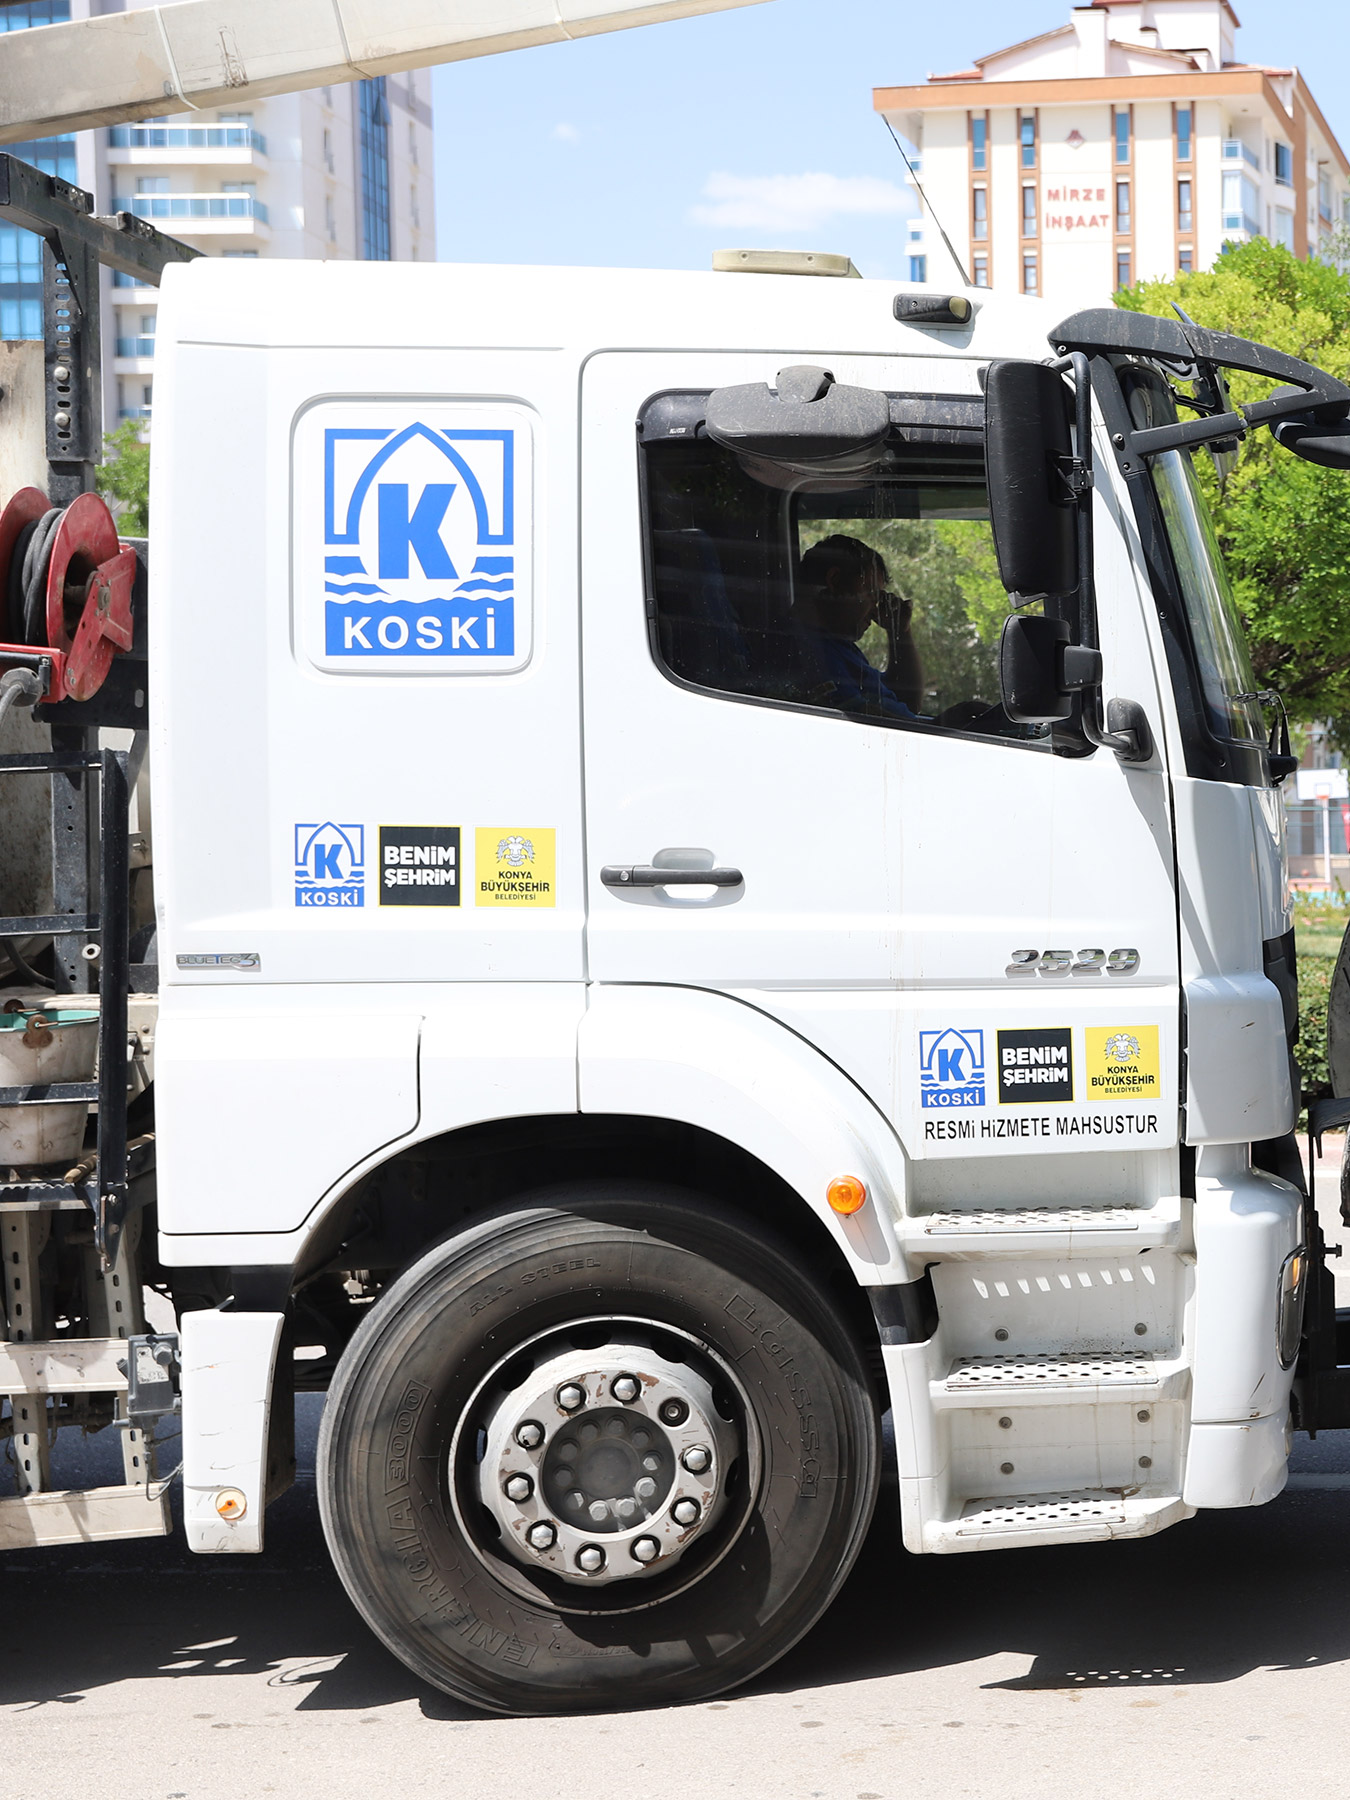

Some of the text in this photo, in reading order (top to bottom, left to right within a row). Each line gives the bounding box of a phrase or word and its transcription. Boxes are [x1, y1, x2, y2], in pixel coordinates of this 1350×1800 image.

[1047, 185, 1105, 201] MİRZE
[1045, 212, 1109, 232] İNŞAAT
[378, 483, 460, 580] K
[344, 607, 496, 650] KOSKİ
[314, 843, 345, 879] K
[498, 870, 533, 880] KONYA
[480, 879, 550, 894] BÜYÜKŞEHİR
[301, 889, 359, 905] KOSKİ
[494, 893, 537, 901] BELEDİYESİ
[1005, 948, 1141, 979] 2529
[937, 1048, 966, 1082] K
[1107, 1065, 1139, 1074] KONYA
[1091, 1072, 1155, 1087] BÜYÜKŞEHİR
[927, 1089, 980, 1106] KOSKİ
[1104, 1086, 1143, 1094] BELEDİYESİ
[1056, 1114, 1159, 1136] MAHSUSTUR
